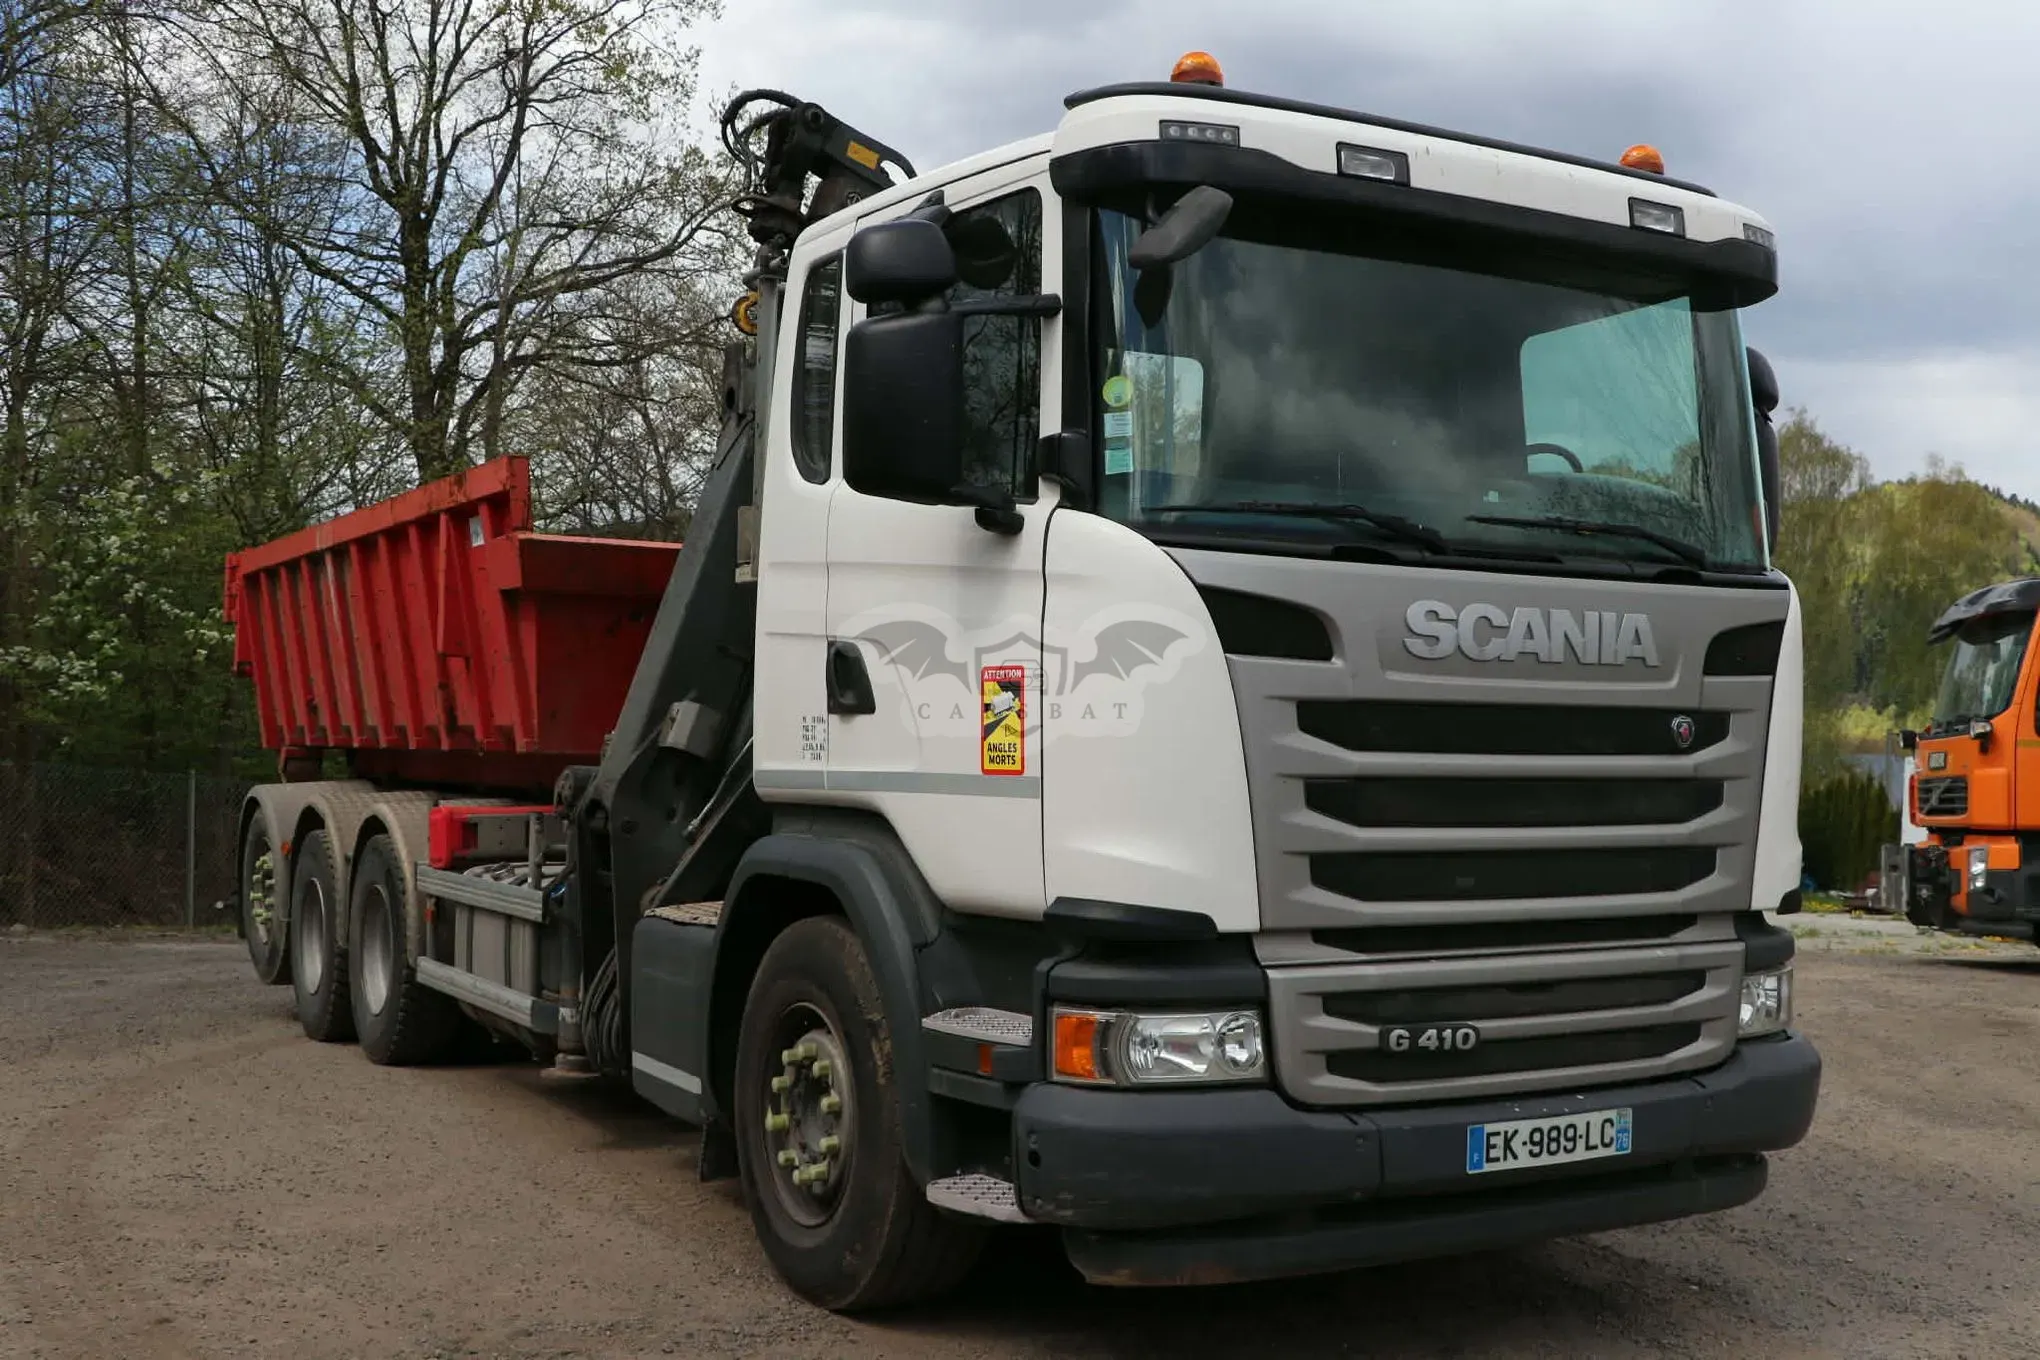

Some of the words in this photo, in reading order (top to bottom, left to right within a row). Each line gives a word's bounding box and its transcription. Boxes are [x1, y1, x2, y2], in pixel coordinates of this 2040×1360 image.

[1402, 600, 1661, 667] SCANIA
[984, 669, 1022, 679] ATTENTION
[987, 742, 1018, 753] ANGLES
[988, 754, 1017, 766] MORTS
[1388, 1028, 1411, 1051] G
[1417, 1027, 1477, 1050] 410
[1485, 1117, 1615, 1164] EK-989-LC
